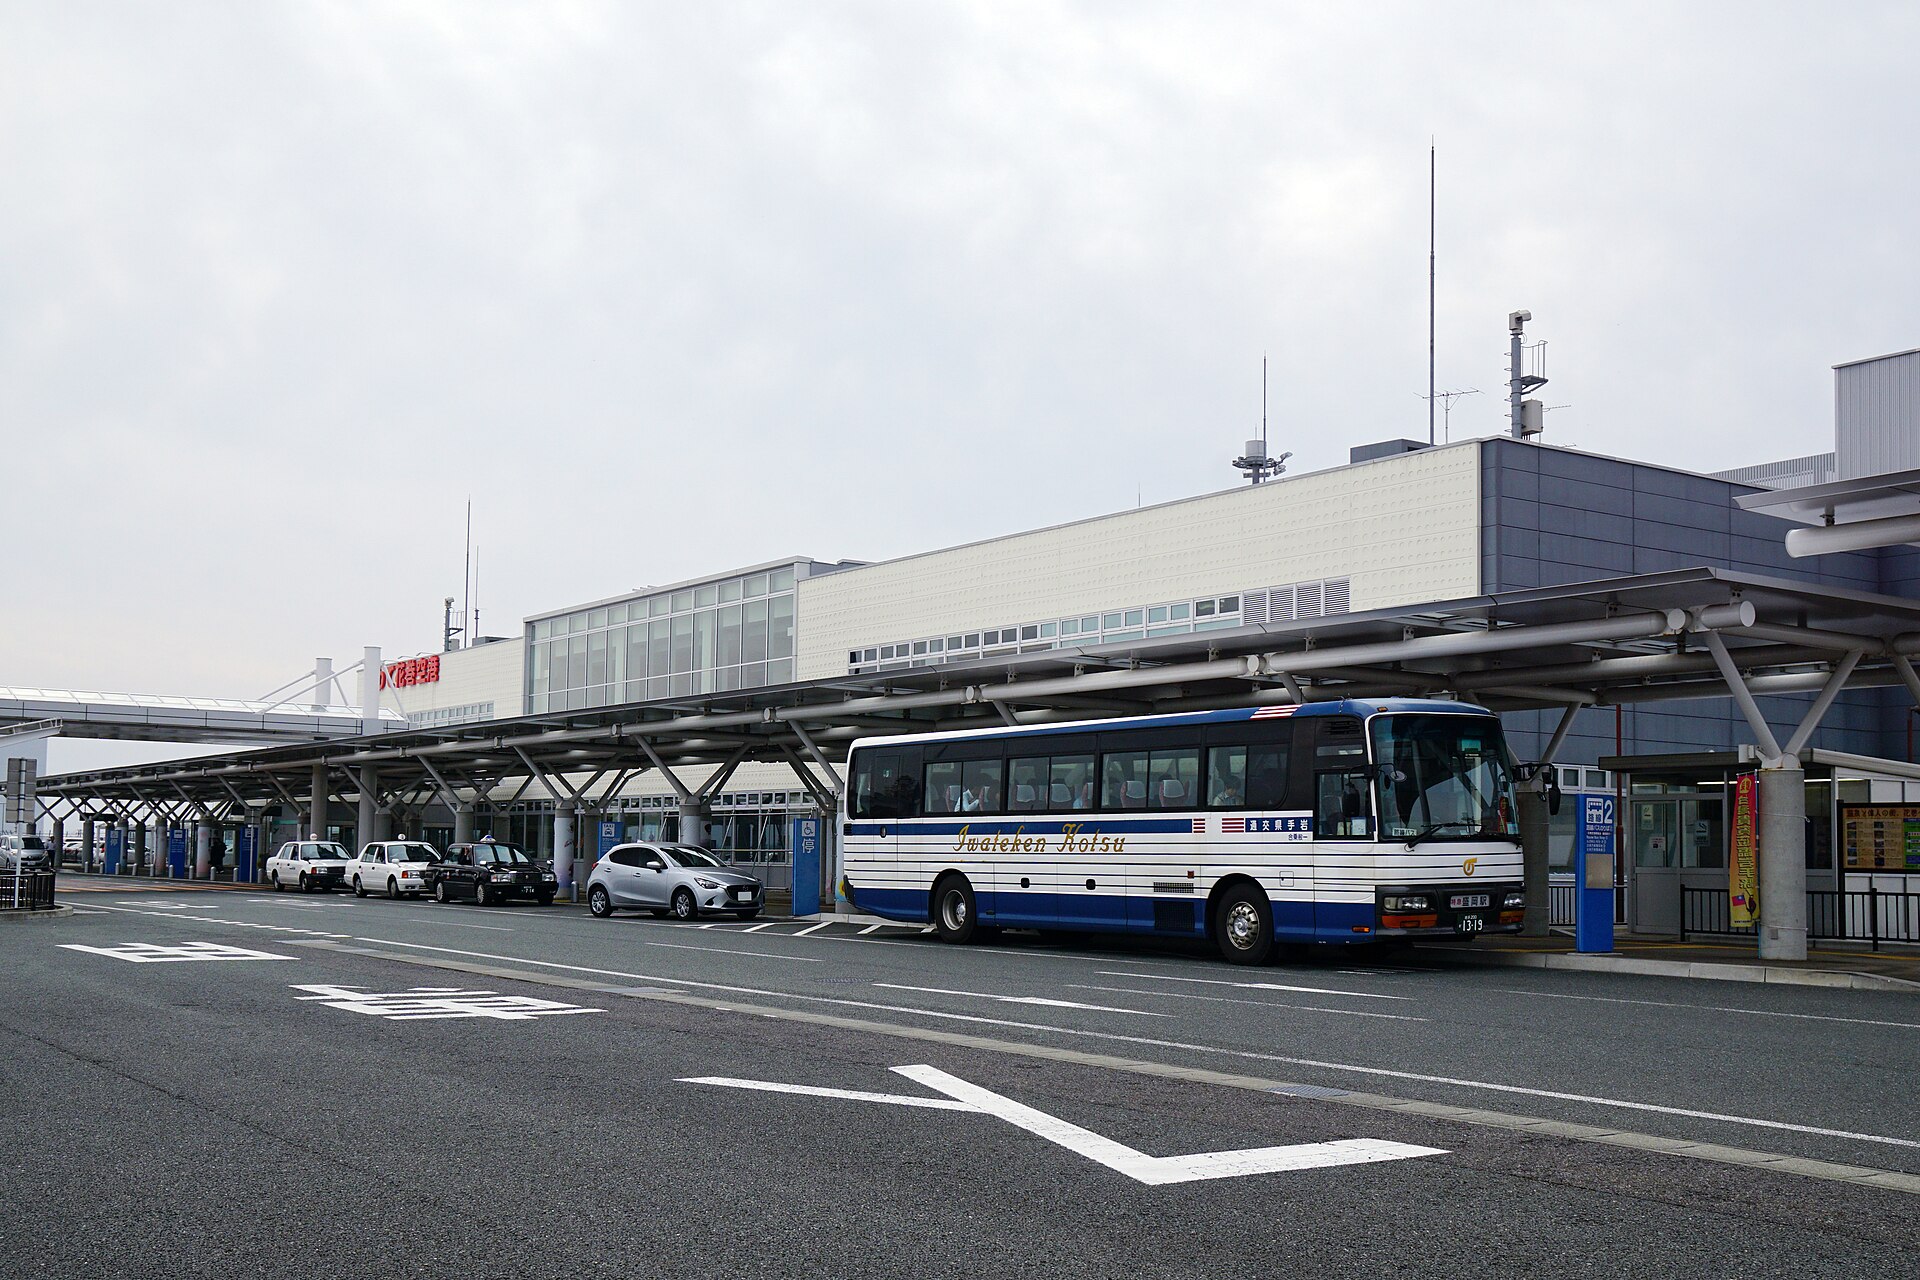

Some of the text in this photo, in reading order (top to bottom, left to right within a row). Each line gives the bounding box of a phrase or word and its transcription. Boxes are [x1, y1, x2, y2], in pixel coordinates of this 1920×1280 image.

[1604, 800, 1613, 823] 2
[802, 838, 815, 853] 停
[953, 823, 1126, 853] Iwateken Kotsu
